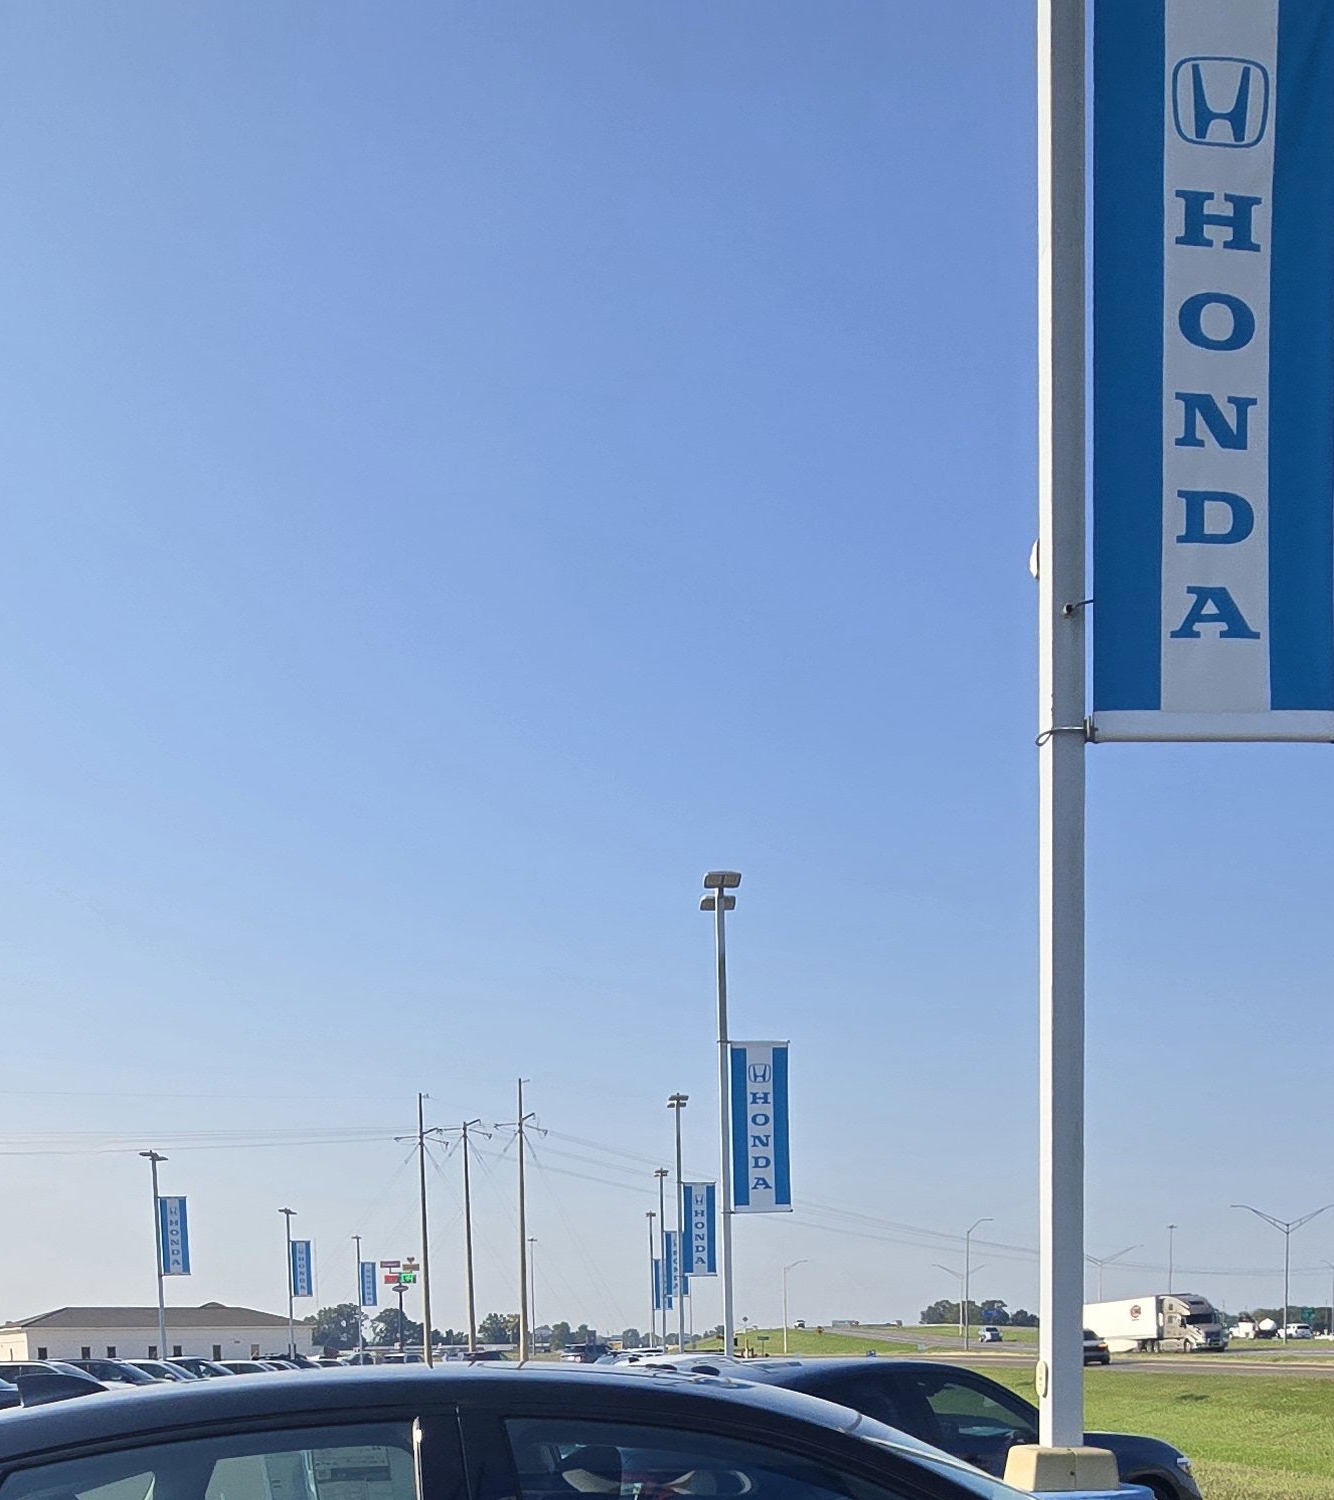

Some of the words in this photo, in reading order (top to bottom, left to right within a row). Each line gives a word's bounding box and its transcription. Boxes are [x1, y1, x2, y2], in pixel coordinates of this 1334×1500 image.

[1169, 188, 1262, 640] HONDA
[749, 1092, 772, 1190] HONDA
[169, 1219, 181, 1266] HONDA
[694, 1210, 706, 1264] HONDA
